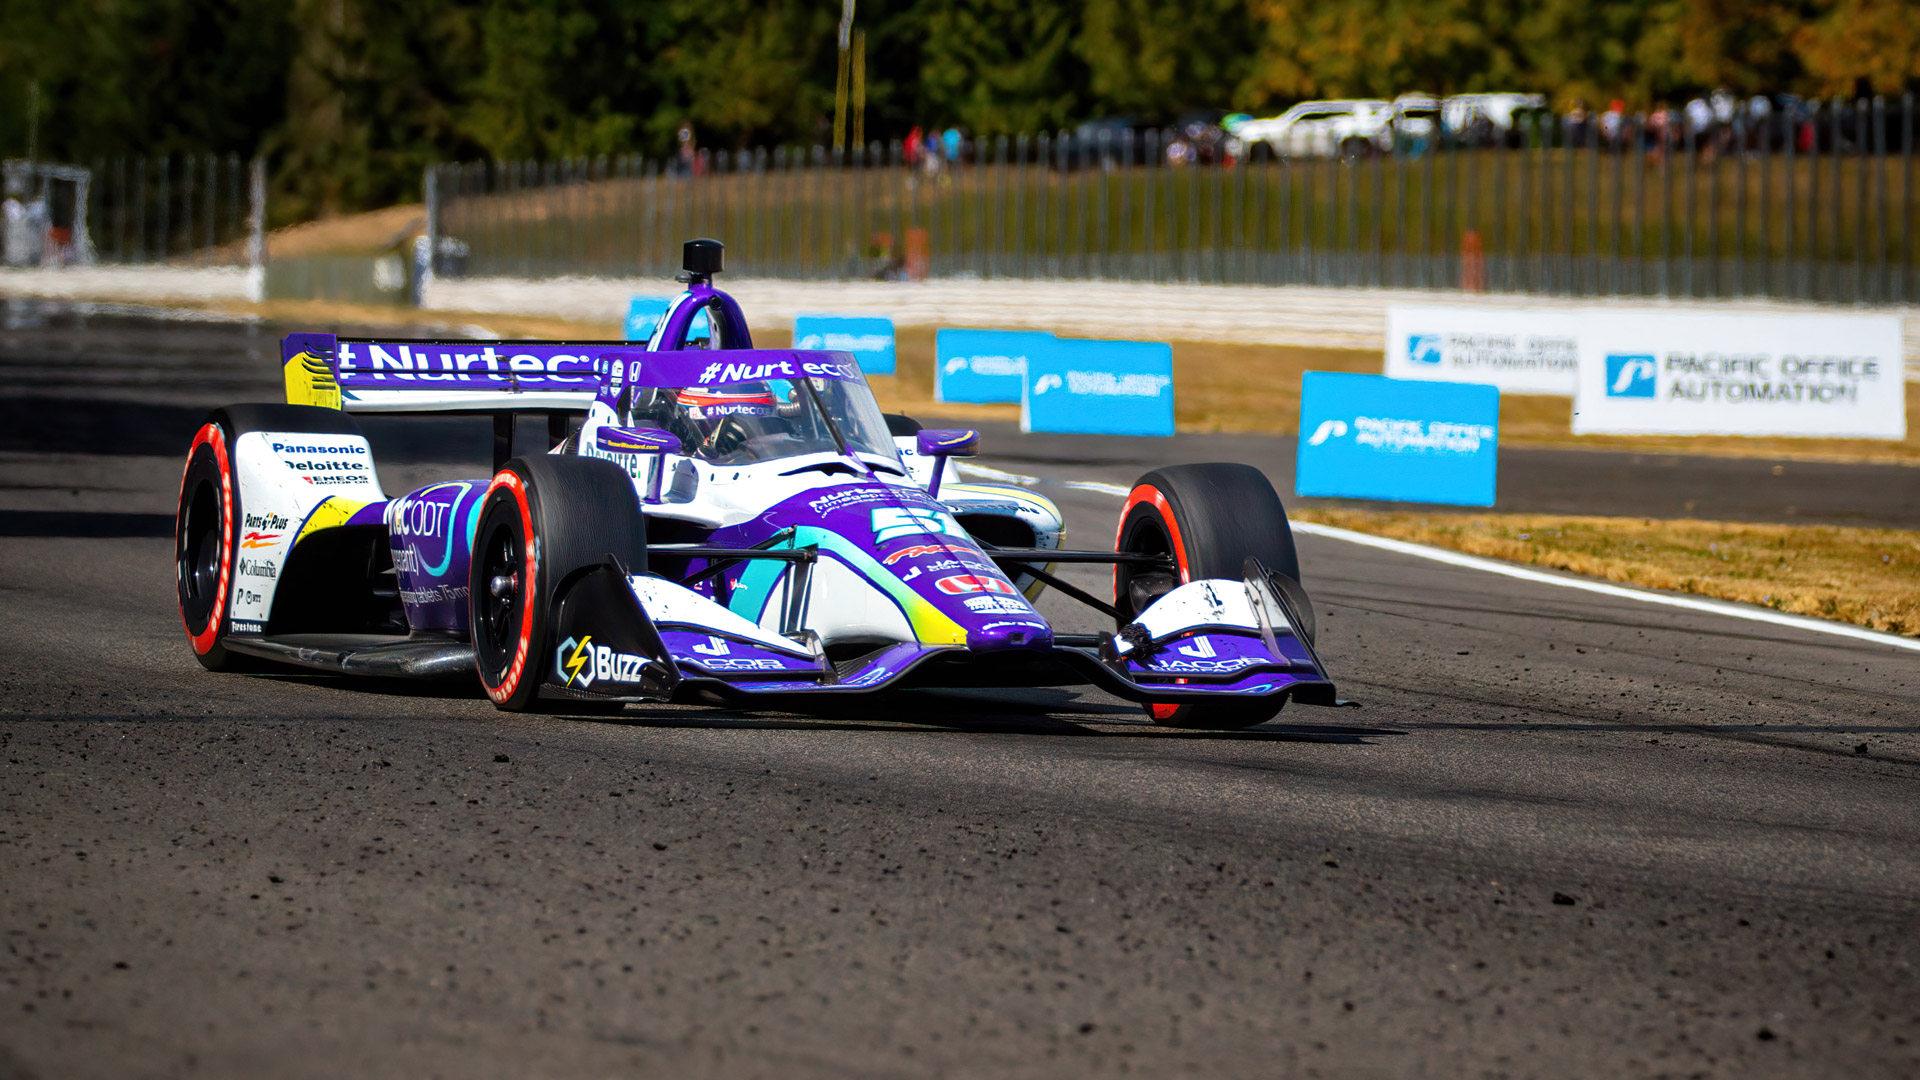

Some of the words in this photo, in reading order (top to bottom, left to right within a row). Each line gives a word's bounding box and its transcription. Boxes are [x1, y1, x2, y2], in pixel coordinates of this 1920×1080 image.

[1665, 353, 1772, 377] PACIFIC
[1780, 355, 1881, 379] OFFICE
[1671, 380, 1858, 402] AUTOMATION
[272, 442, 366, 454] Panasonic
[245, 513, 263, 528] PARTS
[270, 515, 289, 530] PLUS
[245, 559, 277, 579] Columbia
[231, 621, 262, 633] Firestone
